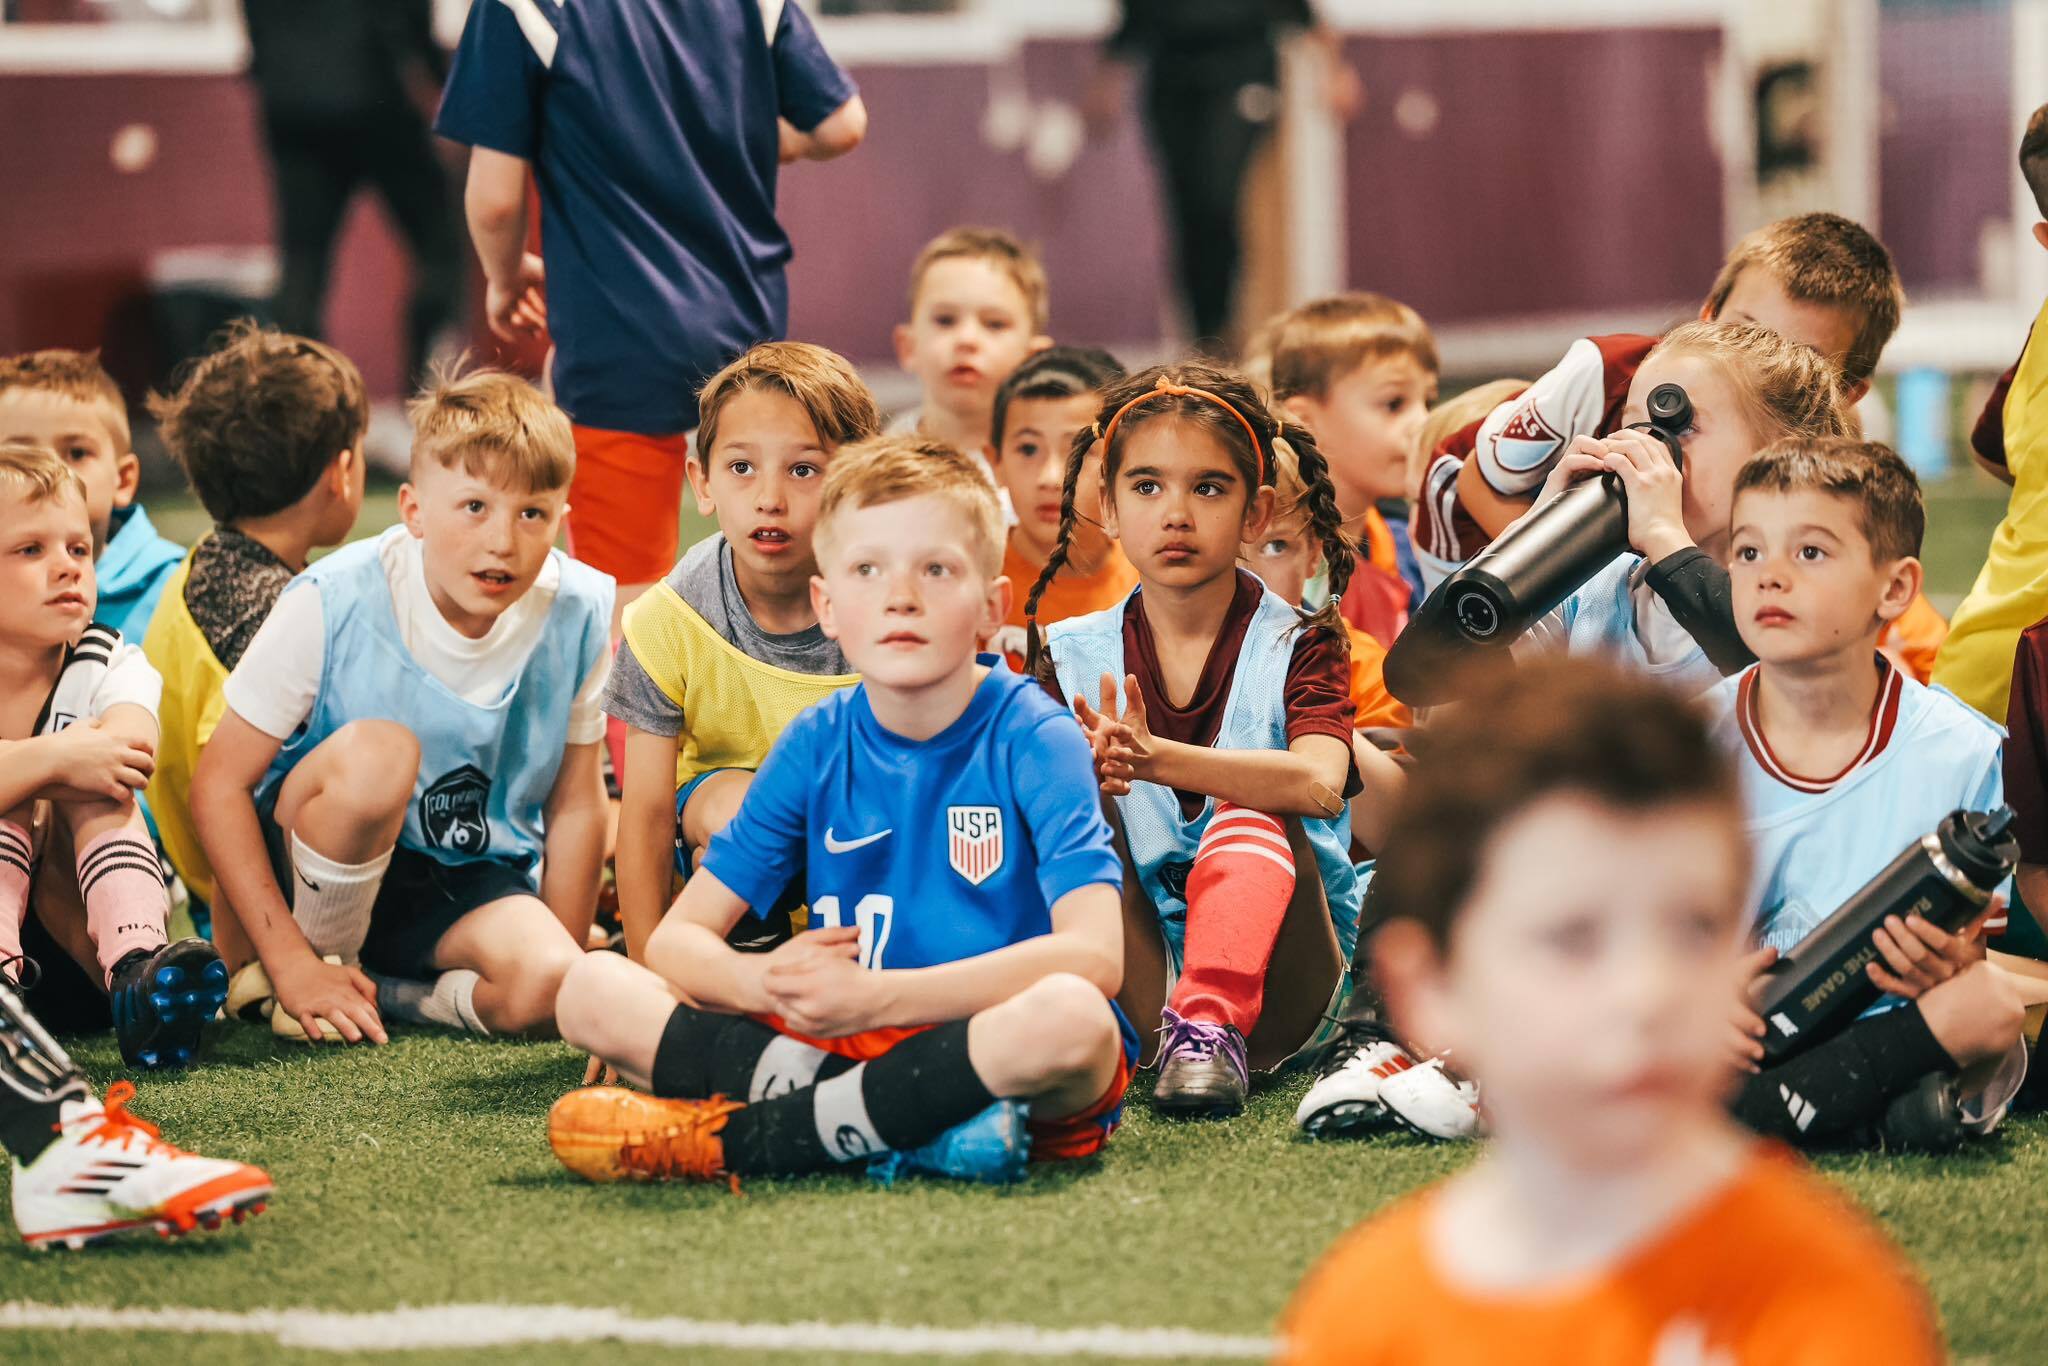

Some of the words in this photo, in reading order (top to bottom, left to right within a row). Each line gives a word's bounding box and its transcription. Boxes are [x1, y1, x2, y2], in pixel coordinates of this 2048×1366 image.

[953, 811, 997, 839] USA
[812, 893, 894, 970] 10
[1844, 947, 1877, 977] THE
[1802, 971, 1846, 1012] GAME
